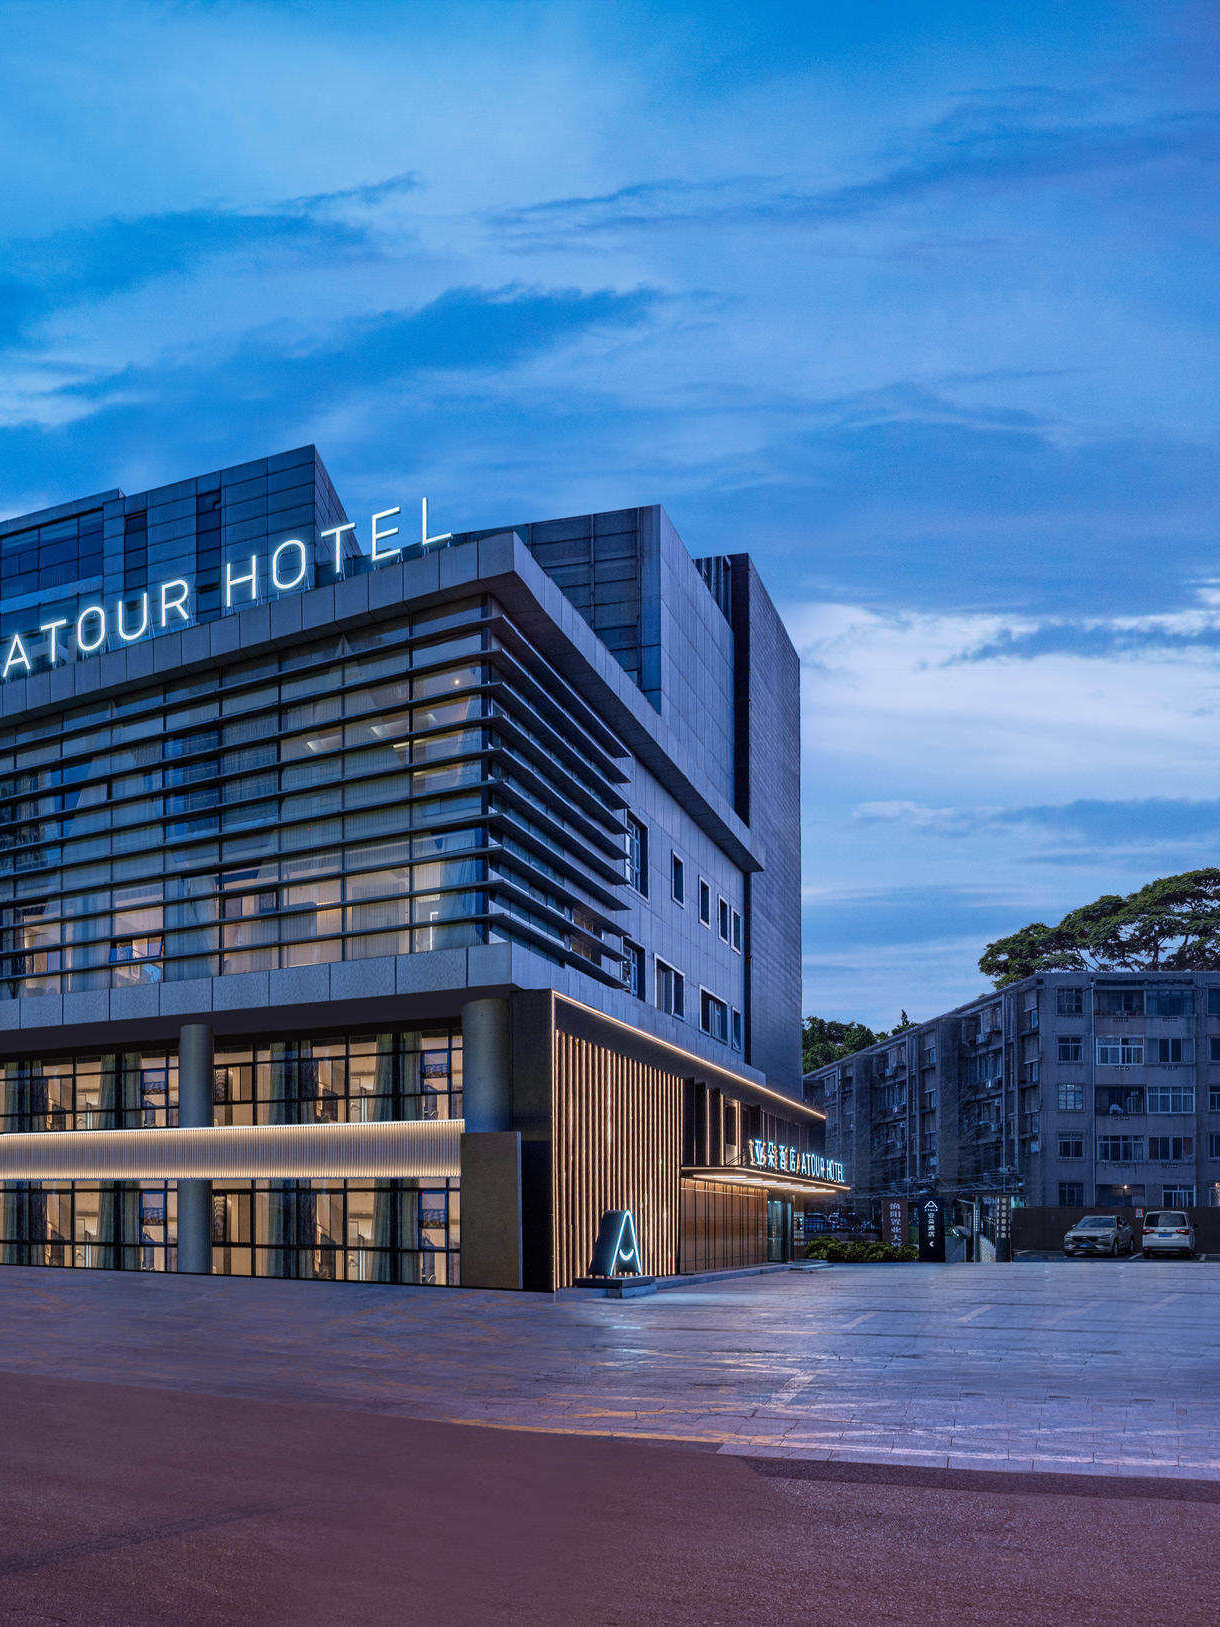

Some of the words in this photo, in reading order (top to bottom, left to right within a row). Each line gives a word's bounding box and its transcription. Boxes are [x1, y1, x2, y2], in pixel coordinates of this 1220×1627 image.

[2, 578, 190, 678] ATOUR
[226, 496, 453, 608] HOTEL
[754, 1139, 797, 1172] 亚朵酒店
[800, 1152, 825, 1179] ATOUR
[826, 1159, 846, 1183] HOTEL
